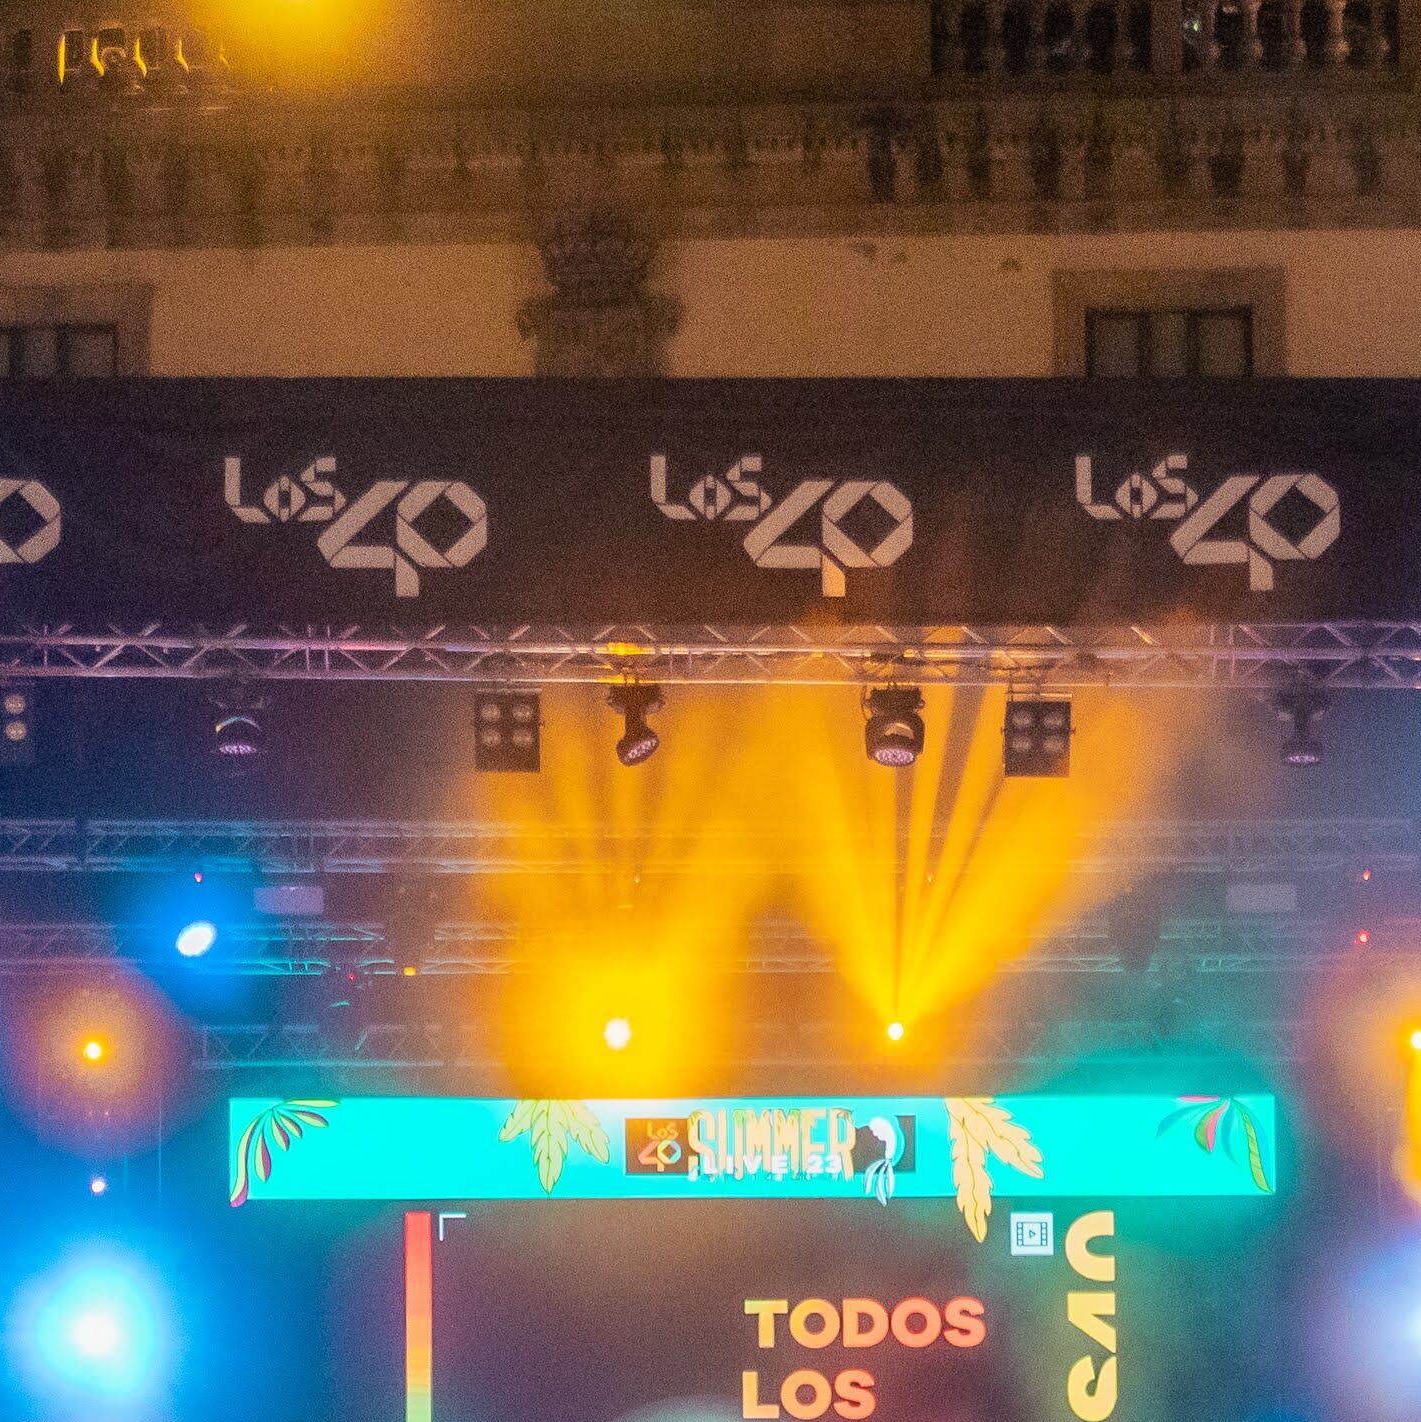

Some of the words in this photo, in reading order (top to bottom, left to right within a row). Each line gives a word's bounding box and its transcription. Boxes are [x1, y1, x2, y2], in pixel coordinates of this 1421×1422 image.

[317, 479, 488, 598] 40
[743, 479, 914, 598] 40
[1169, 472, 1342, 592] 40
[687, 1108, 857, 1182] SUMMER
[702, 1154, 789, 1175] LIVE
[744, 1297, 987, 1349] TODOS
[742, 1368, 877, 1421] LOS
